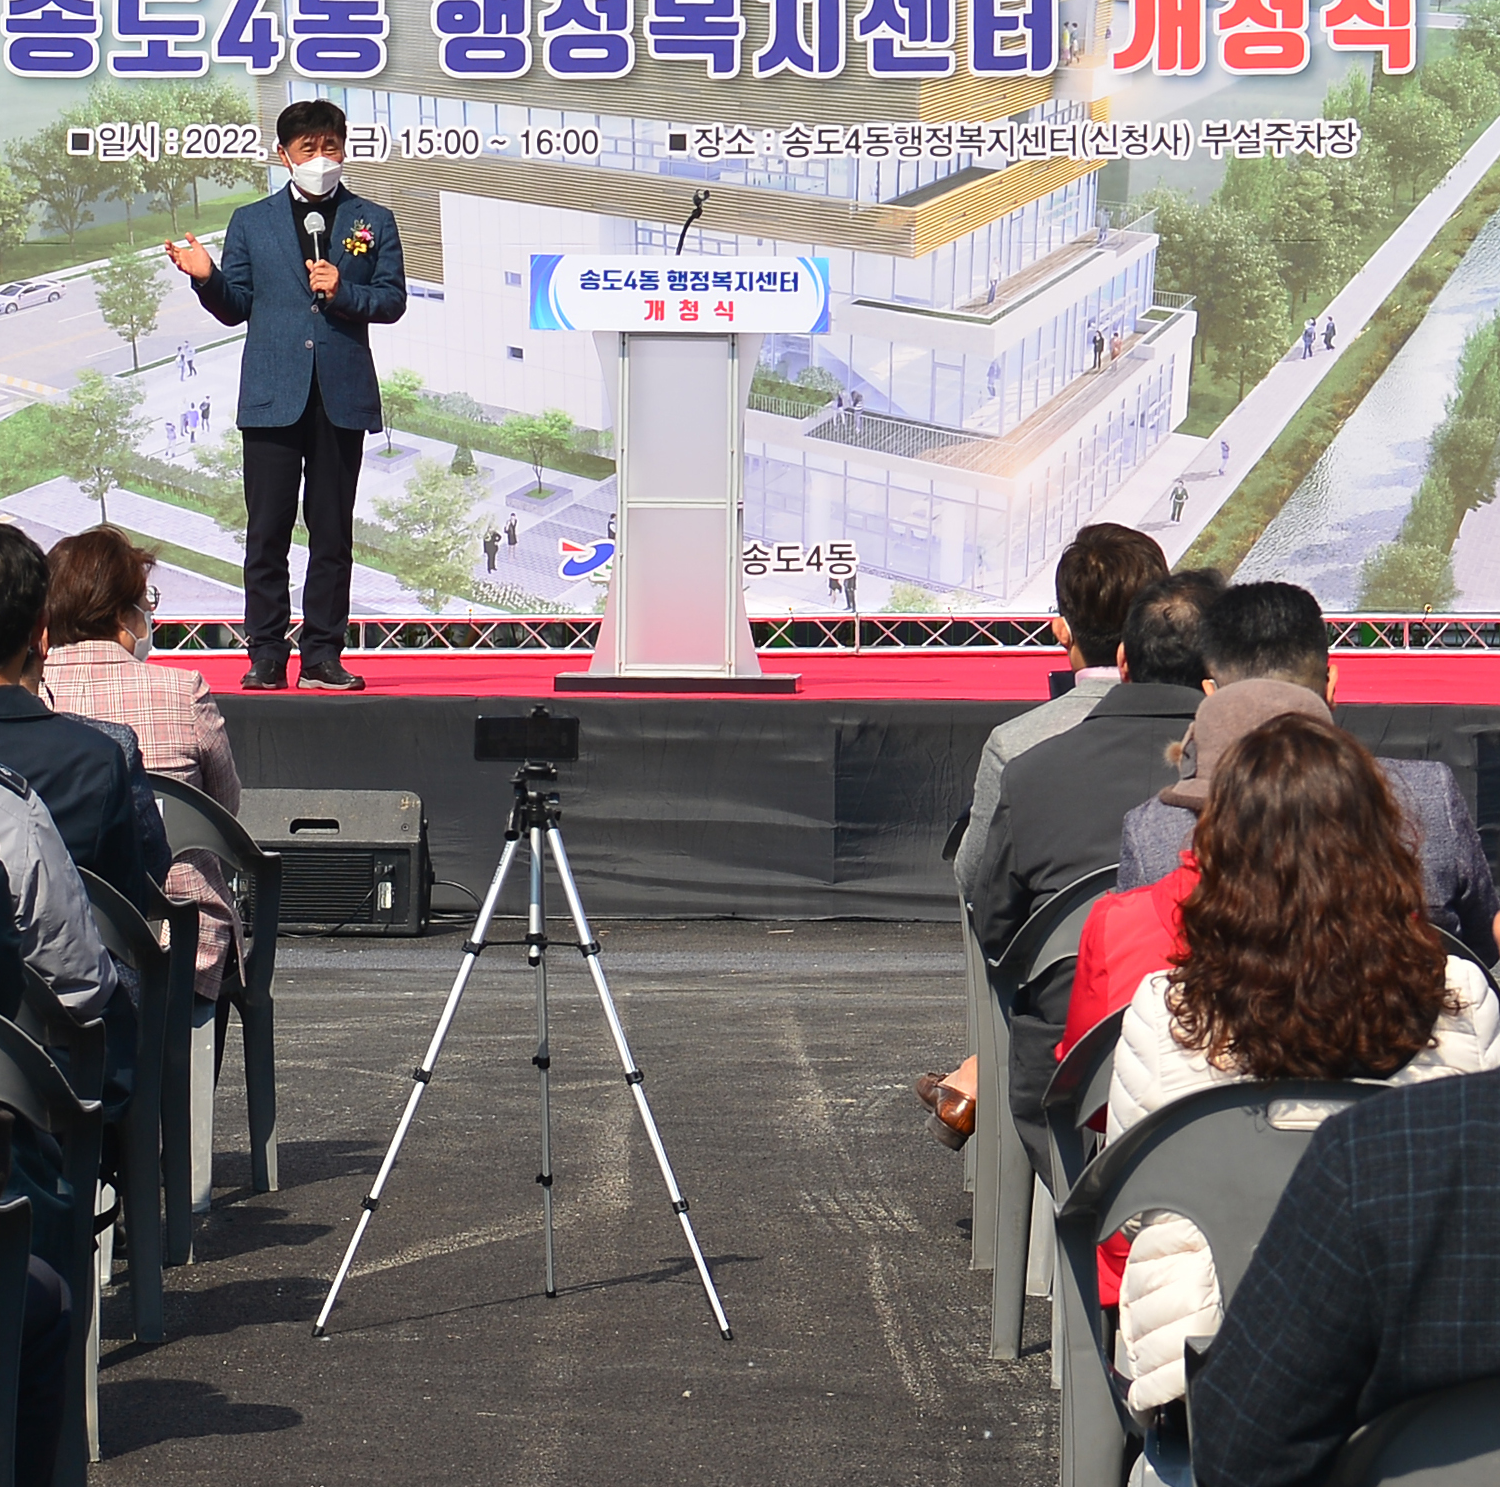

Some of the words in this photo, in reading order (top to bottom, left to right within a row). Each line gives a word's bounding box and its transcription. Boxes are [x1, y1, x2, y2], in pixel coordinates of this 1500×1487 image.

[100, 125, 156, 158] 일시
[184, 128, 266, 158] 2022.
[401, 129, 479, 156] 15:00
[520, 128, 599, 156] 16:00
[694, 125, 754, 156] 장소
[782, 123, 1191, 159] 송도4동행정복지센터(신청사)
[1201, 120, 1357, 156] 부설주차장
[580, 269, 659, 290] 송도4동
[667, 269, 799, 292] 행정복지센터
[742, 543, 856, 575] 송도4동
